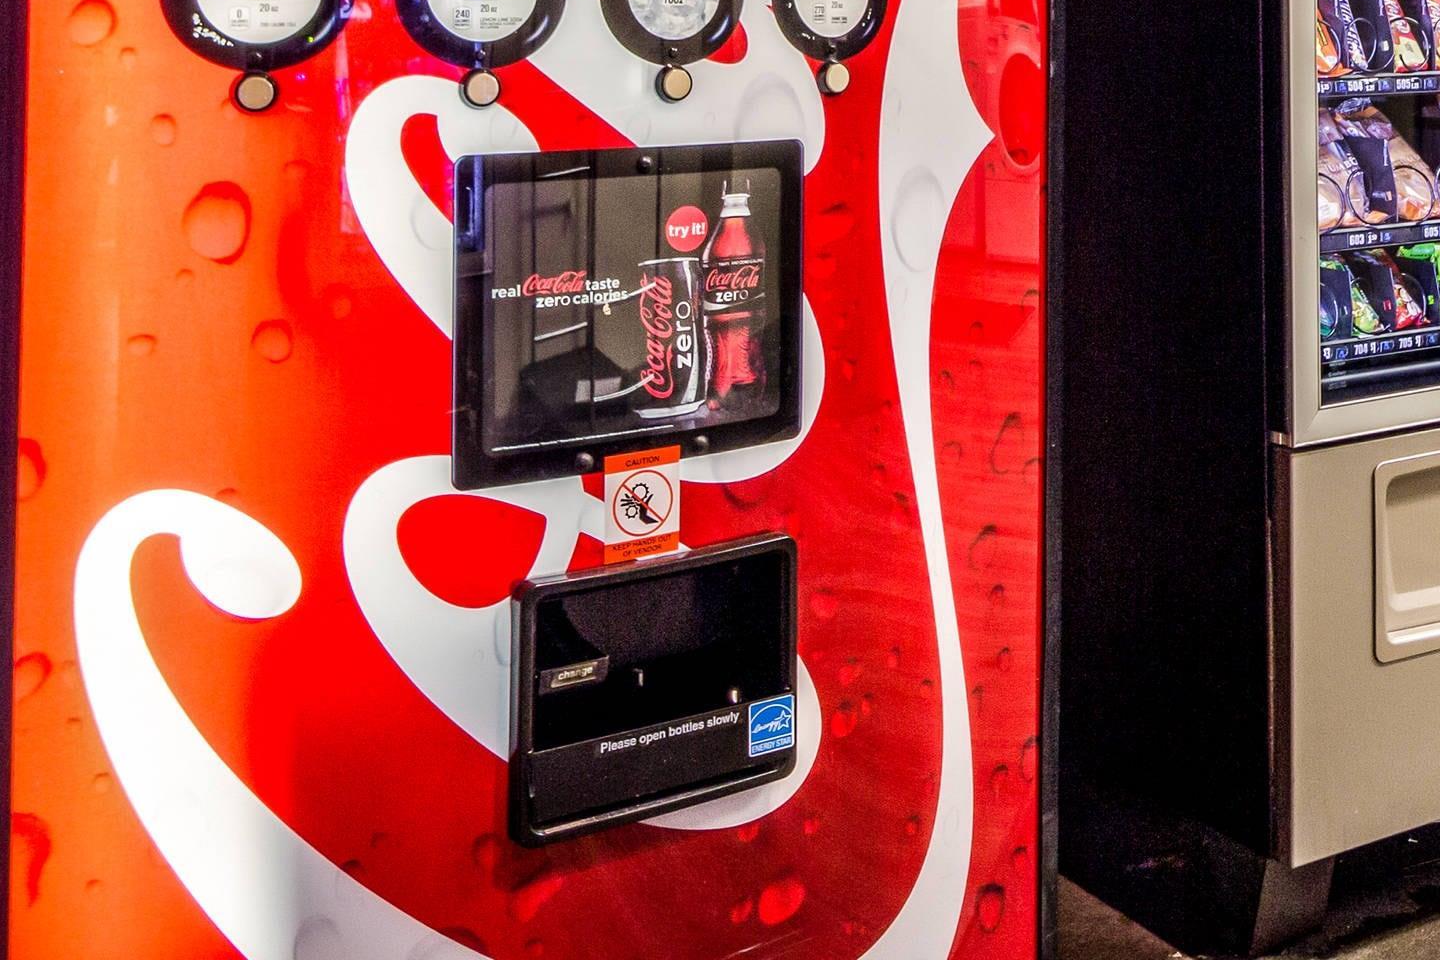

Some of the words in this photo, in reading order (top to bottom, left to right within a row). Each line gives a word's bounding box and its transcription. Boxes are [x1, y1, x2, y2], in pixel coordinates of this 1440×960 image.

[259, 3, 270, 13] 20
[455, 9, 470, 19] 240
[480, 4, 490, 13] 20
[1396, 78, 1411, 90] 505
[668, 224, 689, 239] try
[691, 222, 706, 235] it!
[1424, 227, 1438, 238] 605
[1349, 233, 1364, 245] 603
[492, 285, 521, 298] real
[522, 270, 588, 296] Coca-Cola
[585, 278, 620, 291] taste
[705, 265, 760, 291] Coca-Cola
[535, 295, 571, 308] zero
[572, 289, 628, 304] calories
[715, 290, 749, 302] zero
[639, 272, 673, 400] Coca-Cola
[675, 301, 692, 369] zero
[1399, 337, 1412, 349] 705
[1354, 344, 1368, 355] 704
[625, 456, 660, 467] CAUTION
[558, 665, 594, 681] change
[600, 737, 637, 754] Please
[639, 729, 666, 745] open
[668, 721, 705, 738] bottles
[706, 711, 740, 729] slowly
[750, 740, 775, 754] ENERGY
